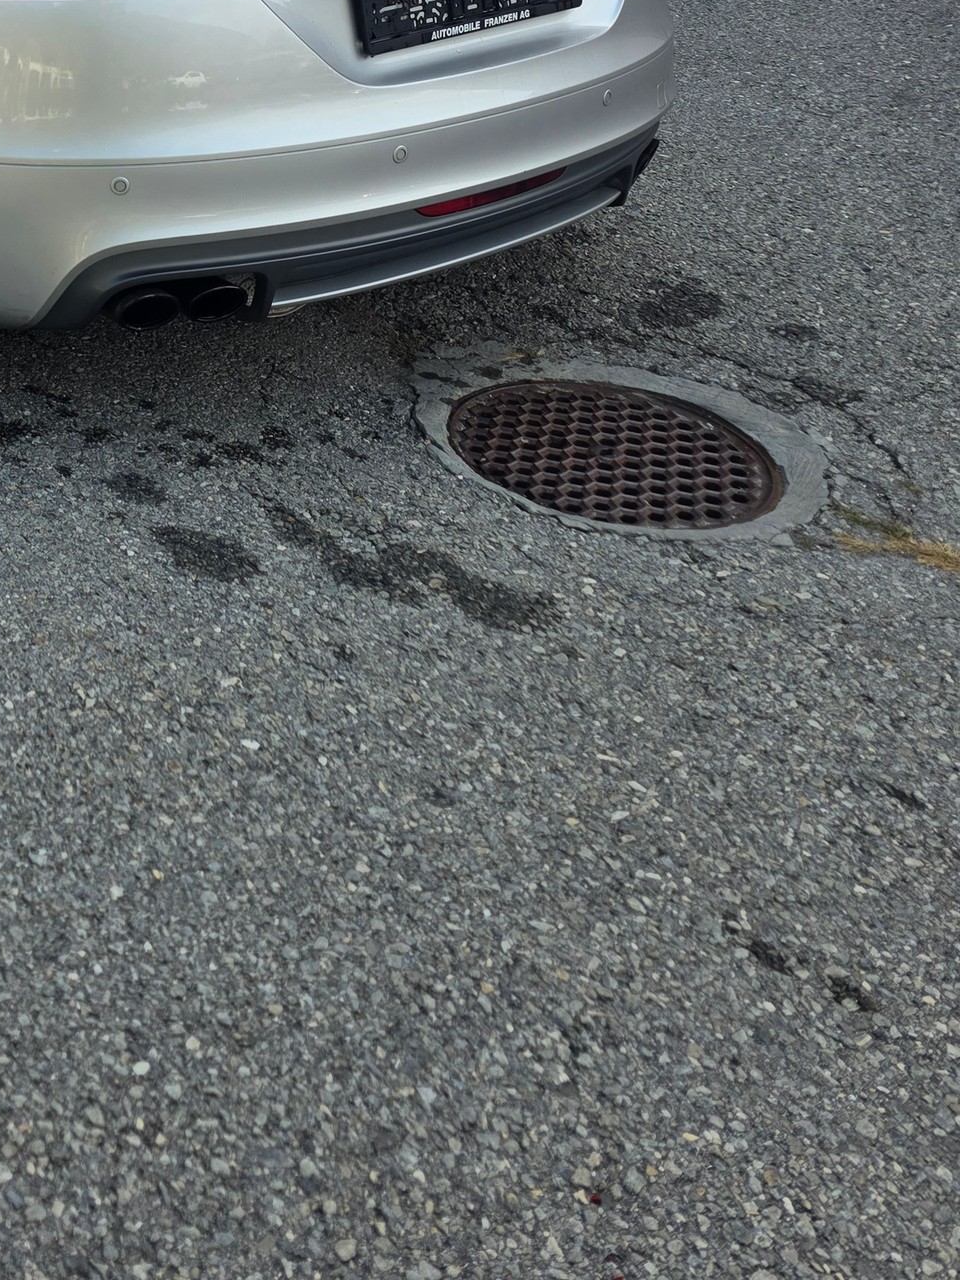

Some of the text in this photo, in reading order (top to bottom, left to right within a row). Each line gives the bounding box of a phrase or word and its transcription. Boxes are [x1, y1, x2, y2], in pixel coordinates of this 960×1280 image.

[431, 9, 530, 41] AUTOMOBILE FRANZEN AG
